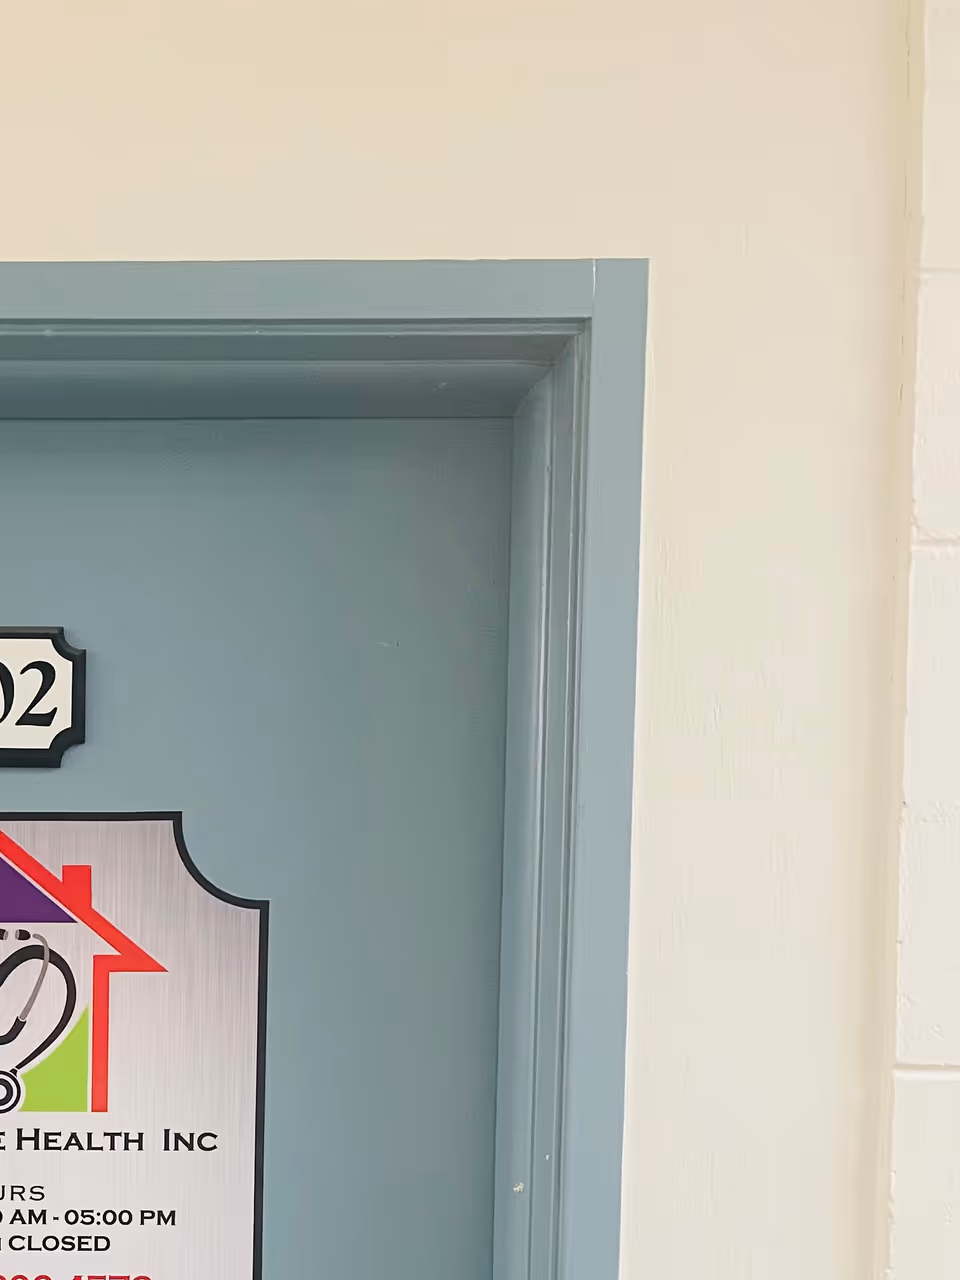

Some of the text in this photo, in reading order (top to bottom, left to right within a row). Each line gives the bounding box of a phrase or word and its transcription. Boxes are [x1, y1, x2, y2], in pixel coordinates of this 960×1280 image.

[15, 1127, 145, 1152] HEALTH
[163, 1128, 219, 1152] INC
[8, 1208, 48, 1225] AM
[64, 1209, 133, 1226] 05:00
[139, 1209, 177, 1227] PM
[8, 1234, 111, 1252] CLOSED
